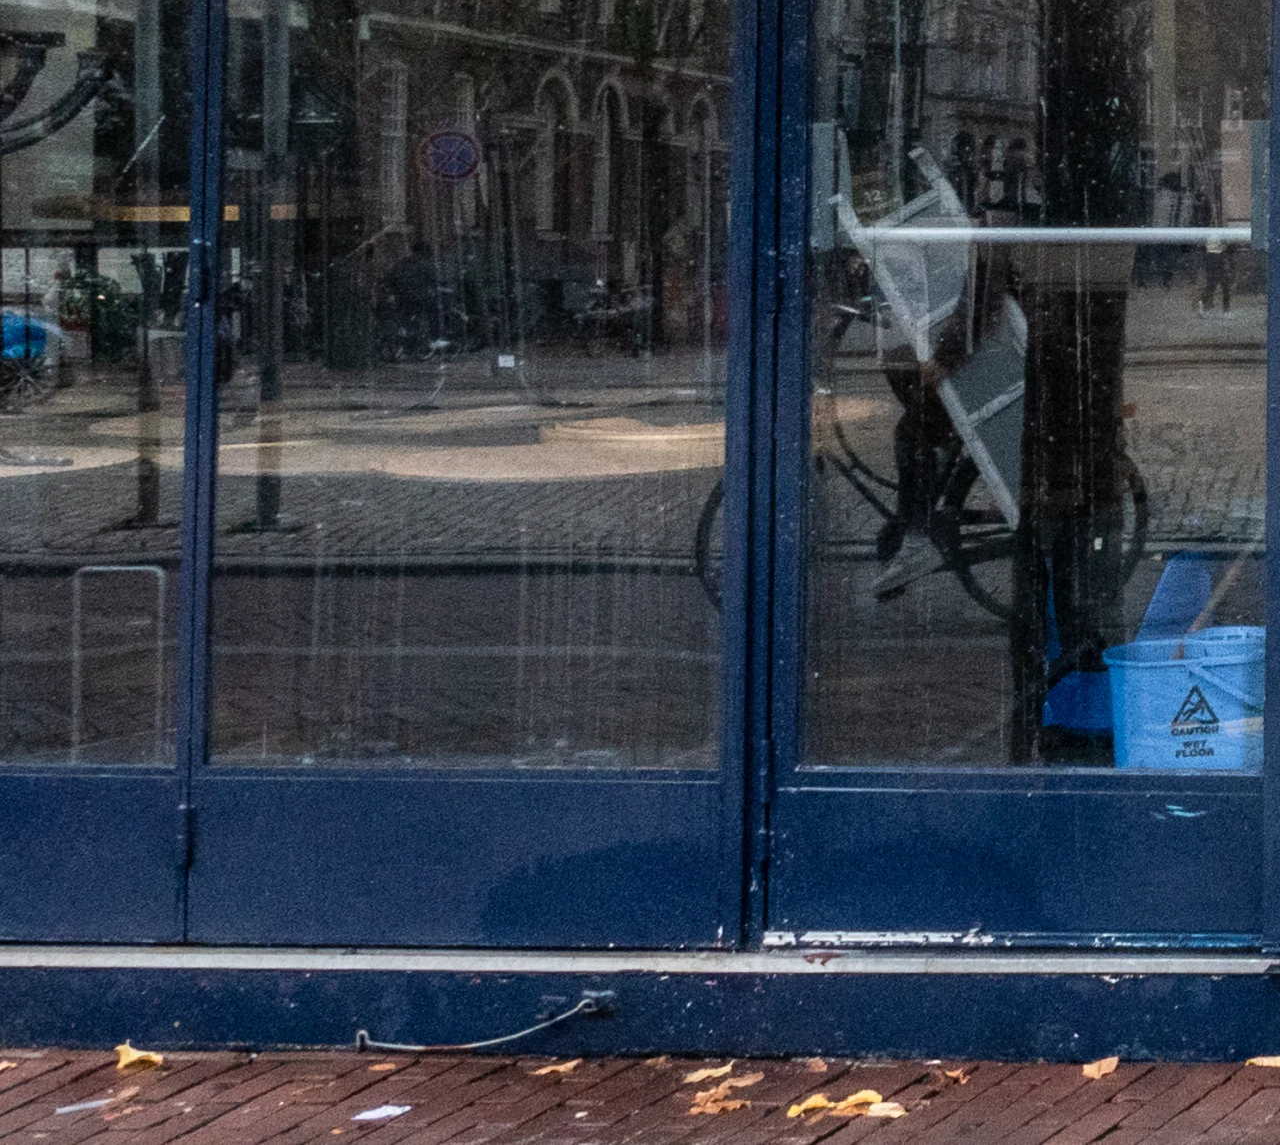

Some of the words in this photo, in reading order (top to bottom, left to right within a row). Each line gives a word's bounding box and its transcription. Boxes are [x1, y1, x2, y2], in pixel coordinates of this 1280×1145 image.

[1170, 725, 1219, 737] CAUTION
[1183, 739, 1207, 749] WET
[1175, 748, 1215, 758] FLOOR
